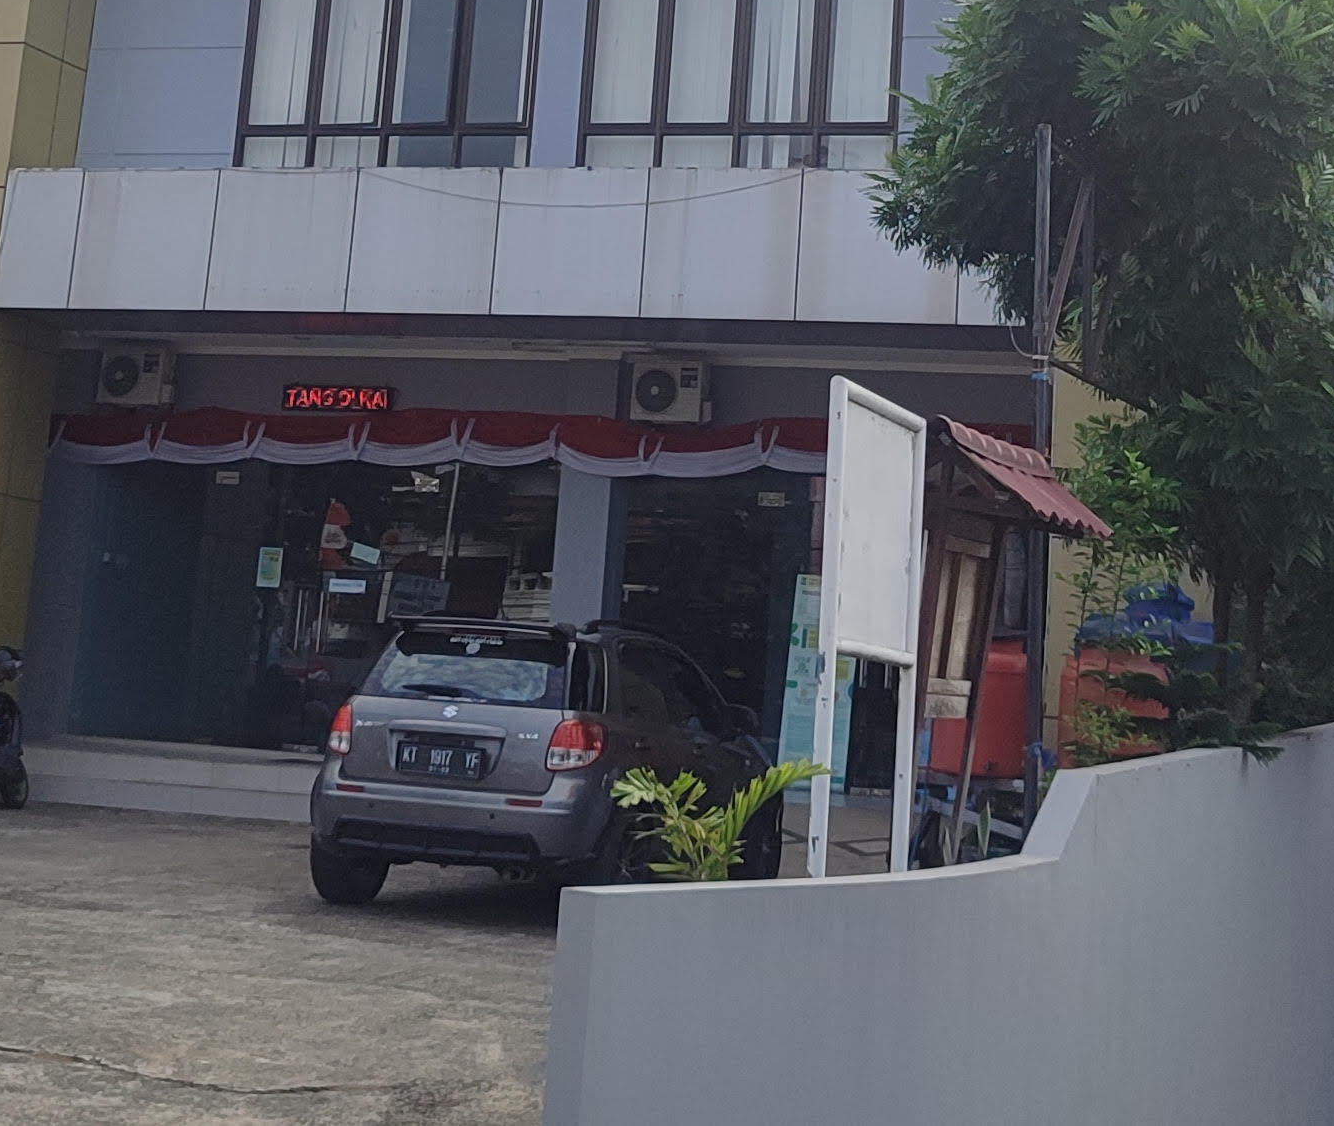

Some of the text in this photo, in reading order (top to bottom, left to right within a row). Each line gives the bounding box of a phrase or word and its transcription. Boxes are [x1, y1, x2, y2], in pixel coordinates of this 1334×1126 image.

[402, 745, 481, 769] KT 1917 YF
